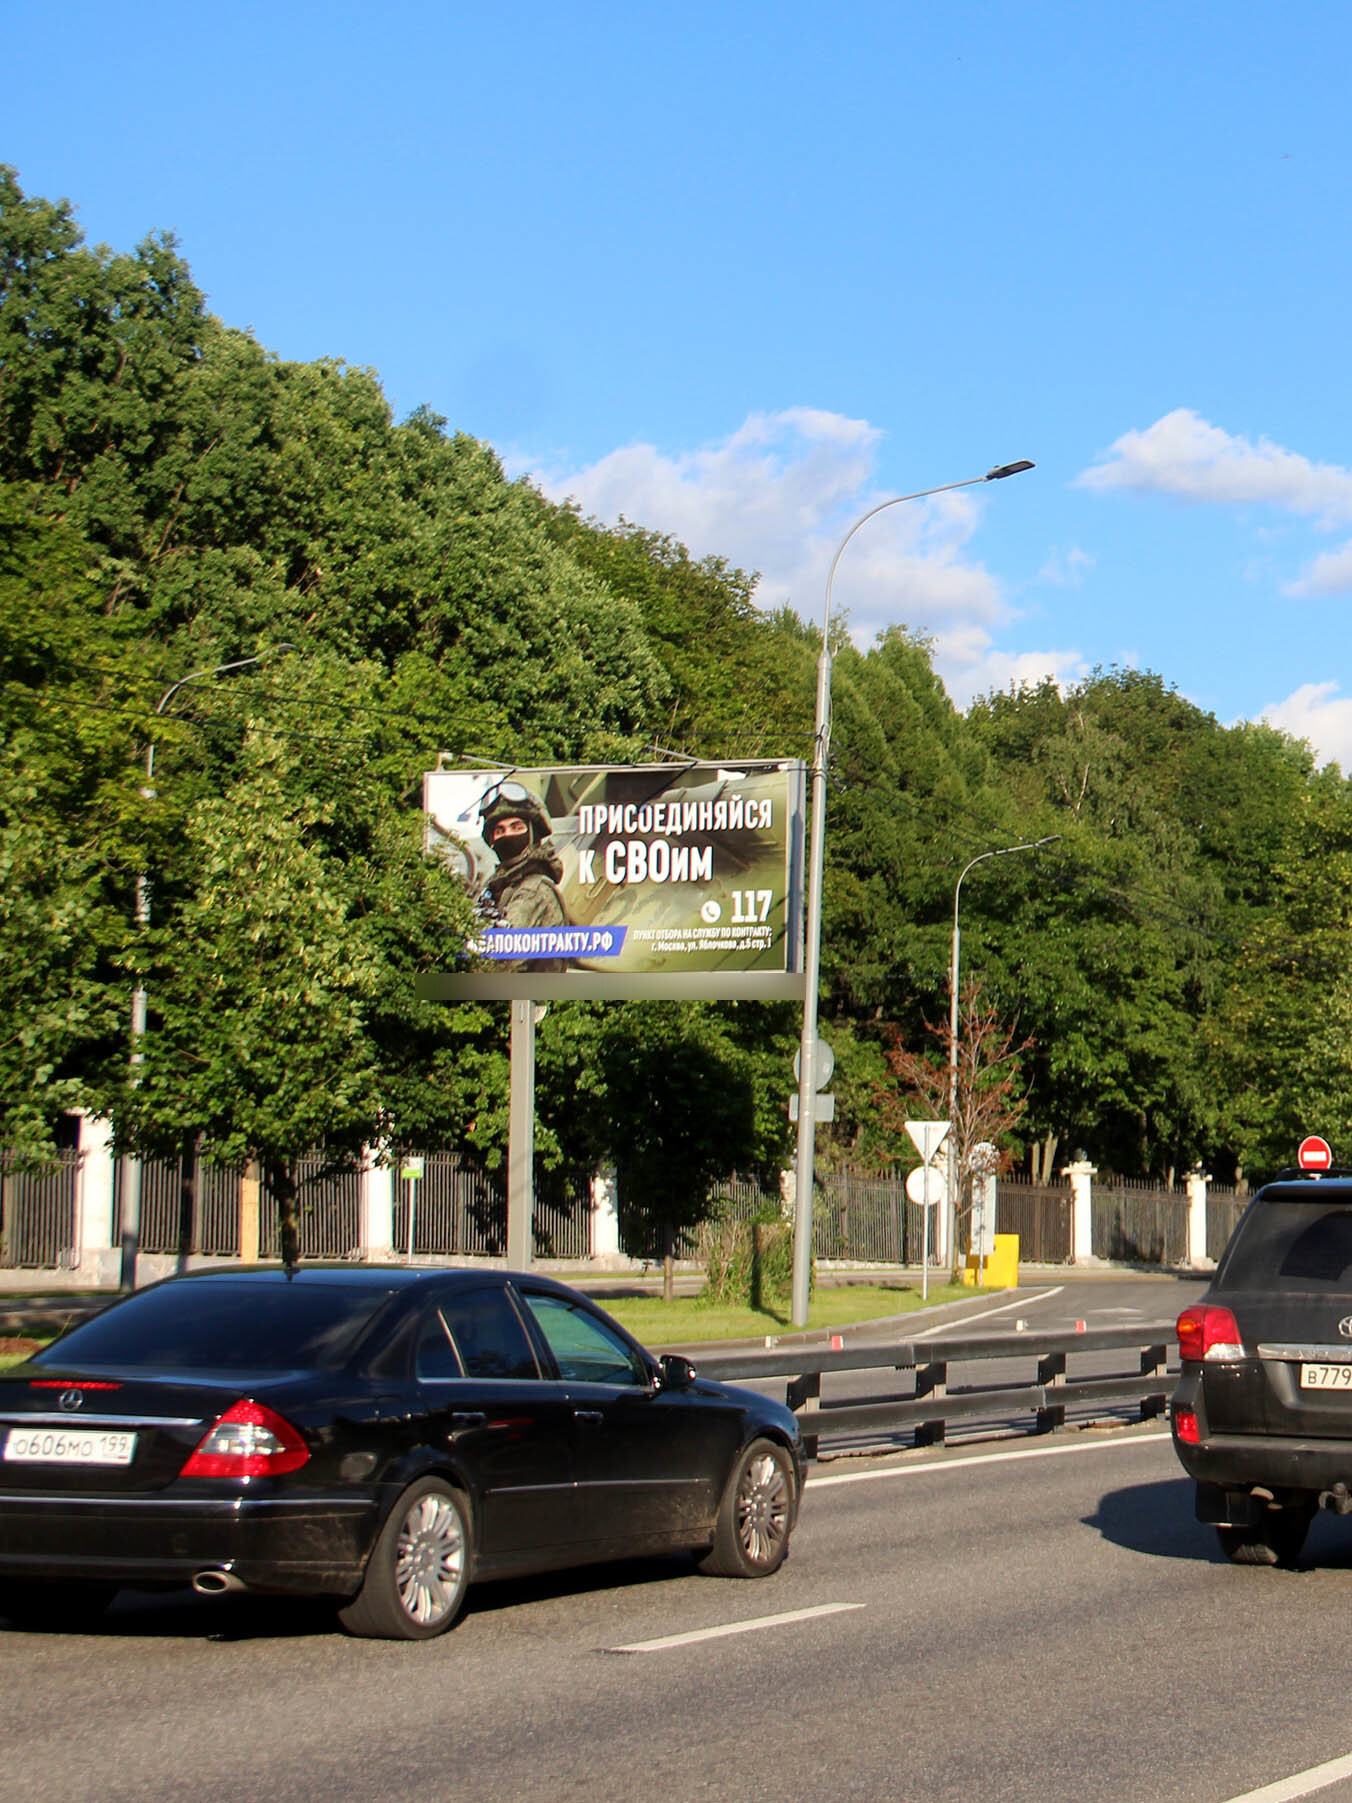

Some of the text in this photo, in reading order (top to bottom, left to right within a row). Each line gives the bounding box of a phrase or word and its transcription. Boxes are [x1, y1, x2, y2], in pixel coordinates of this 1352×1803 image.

[578, 795, 772, 836] ПРИСОЕДИНЯЙСЯ
[731, 890, 773, 923] 117
[656, 928, 682, 941] ОТБОРА
[683, 928, 692, 939] НА
[693, 927, 720, 940] СЛУЖБУ
[721, 927, 731, 938] ПО
[732, 926, 773, 938] КОНТРАКТУ:
[658, 941, 687, 952] Москва,
[688, 941, 698, 952] ул.
